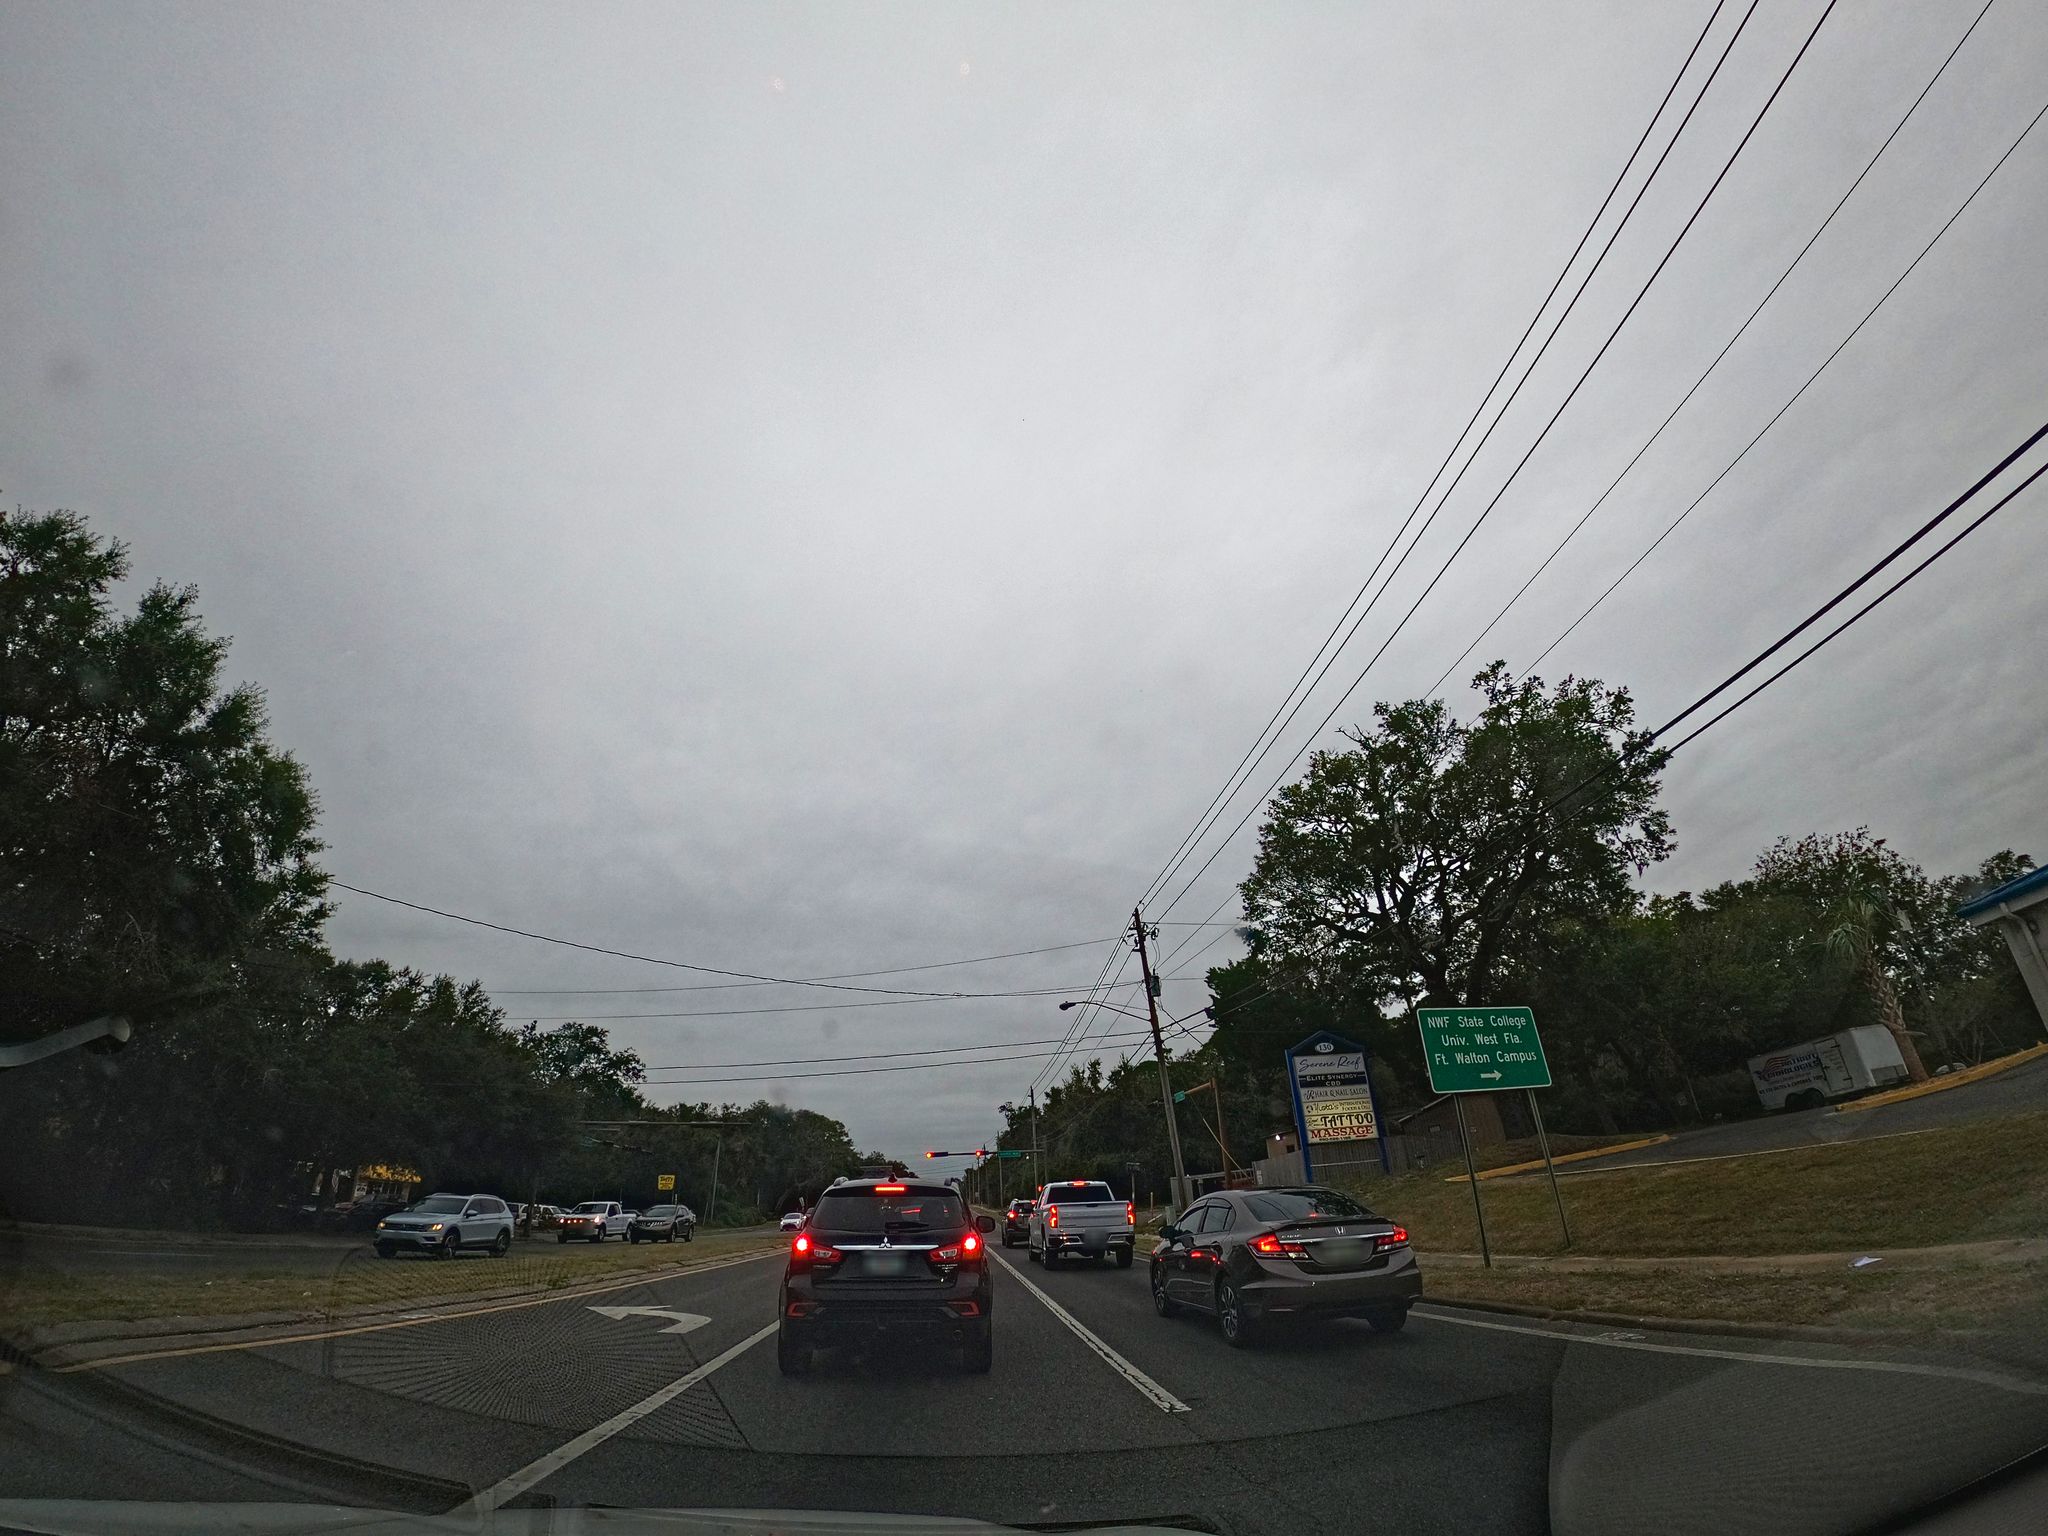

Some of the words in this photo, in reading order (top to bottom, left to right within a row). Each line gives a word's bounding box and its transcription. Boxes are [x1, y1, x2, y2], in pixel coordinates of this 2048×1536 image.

[1427, 1016, 1449, 1028] NWF
[1457, 1016, 1484, 1028] State
[1490, 1015, 1526, 1029] College
[1441, 1034, 1469, 1046] Univ.
[1475, 1033, 1498, 1045] West
[1503, 1032, 1522, 1044] Fla.
[1299, 1058, 1335, 1072] Serene
[1337, 1055, 1361, 1070] Reef
[1435, 1053, 1449, 1065] Ft.
[1455, 1052, 1490, 1064] Walton
[1496, 1051, 1537, 1064] Campus
[1336, 1089, 1349, 1097] NAIL
[1349, 1088, 1368, 1096] SALON
[1320, 1113, 1373, 1128] TATTOO
[1311, 1126, 1374, 1139] MASSAGE
